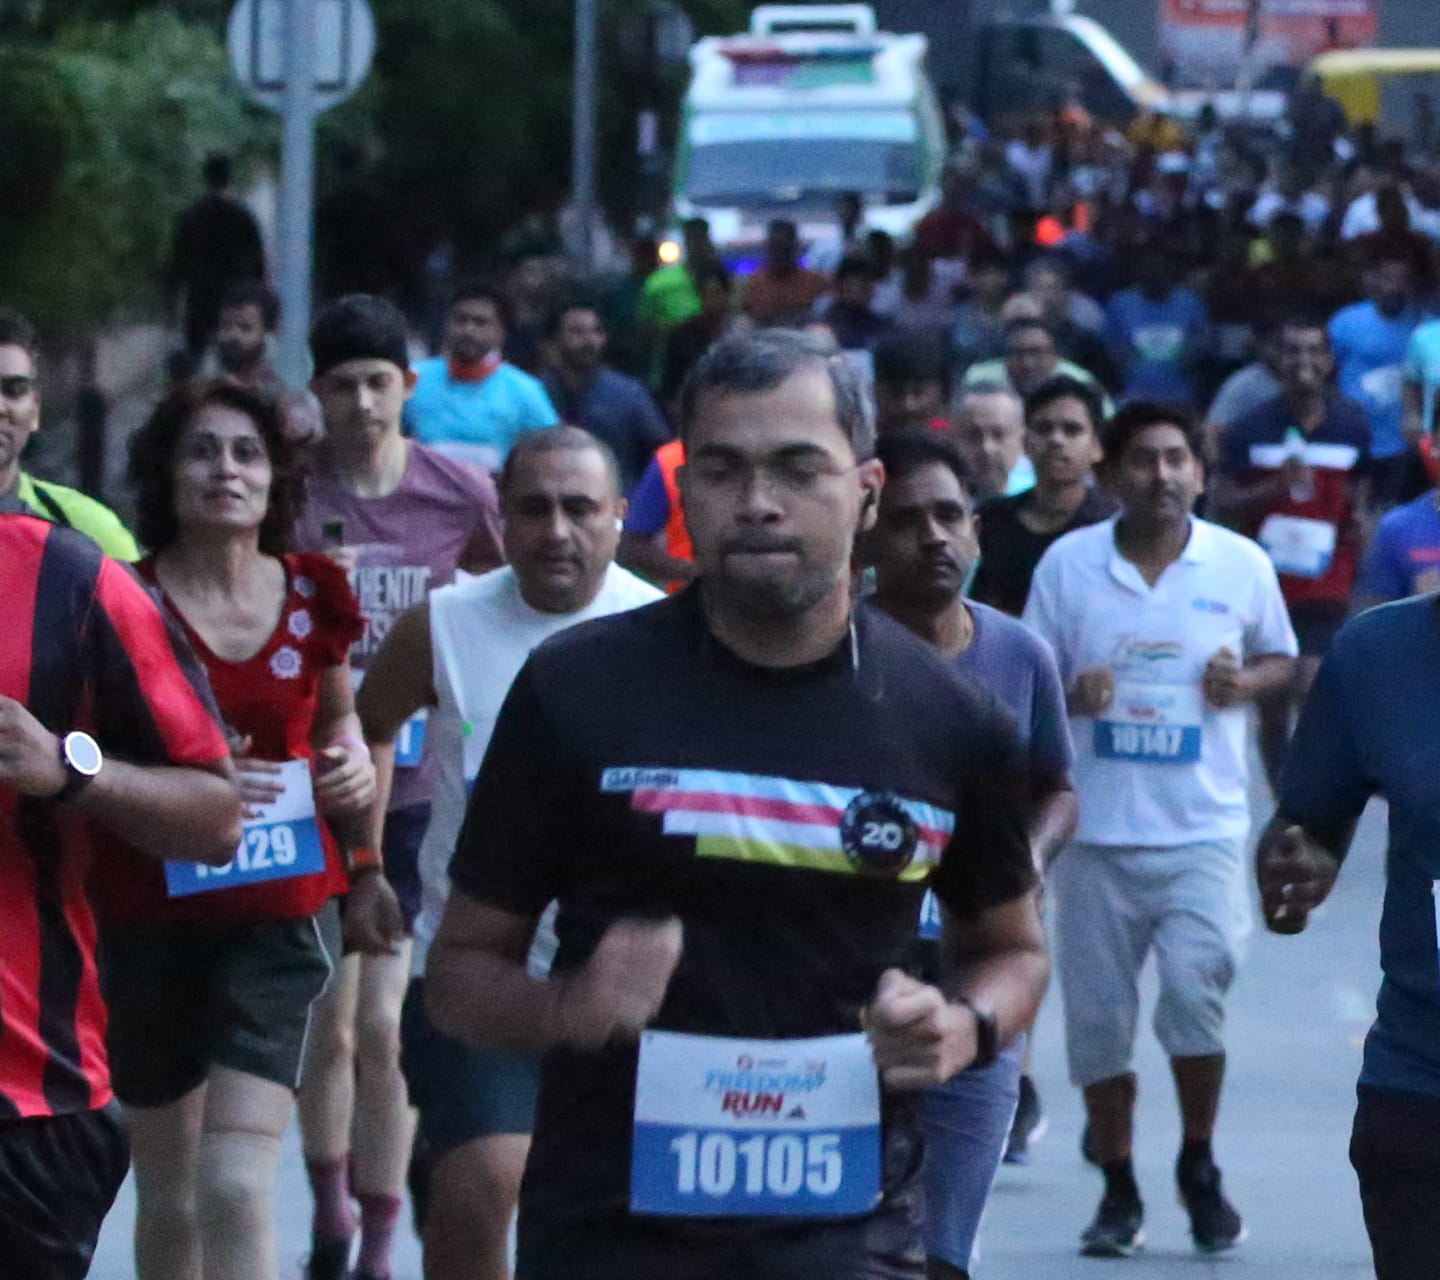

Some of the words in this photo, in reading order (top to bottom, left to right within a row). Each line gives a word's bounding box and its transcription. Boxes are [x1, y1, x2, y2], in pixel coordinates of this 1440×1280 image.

[862, 821, 903, 850] 20
[721, 1091, 785, 1119] RUN
[670, 1132, 844, 1198] 10105
